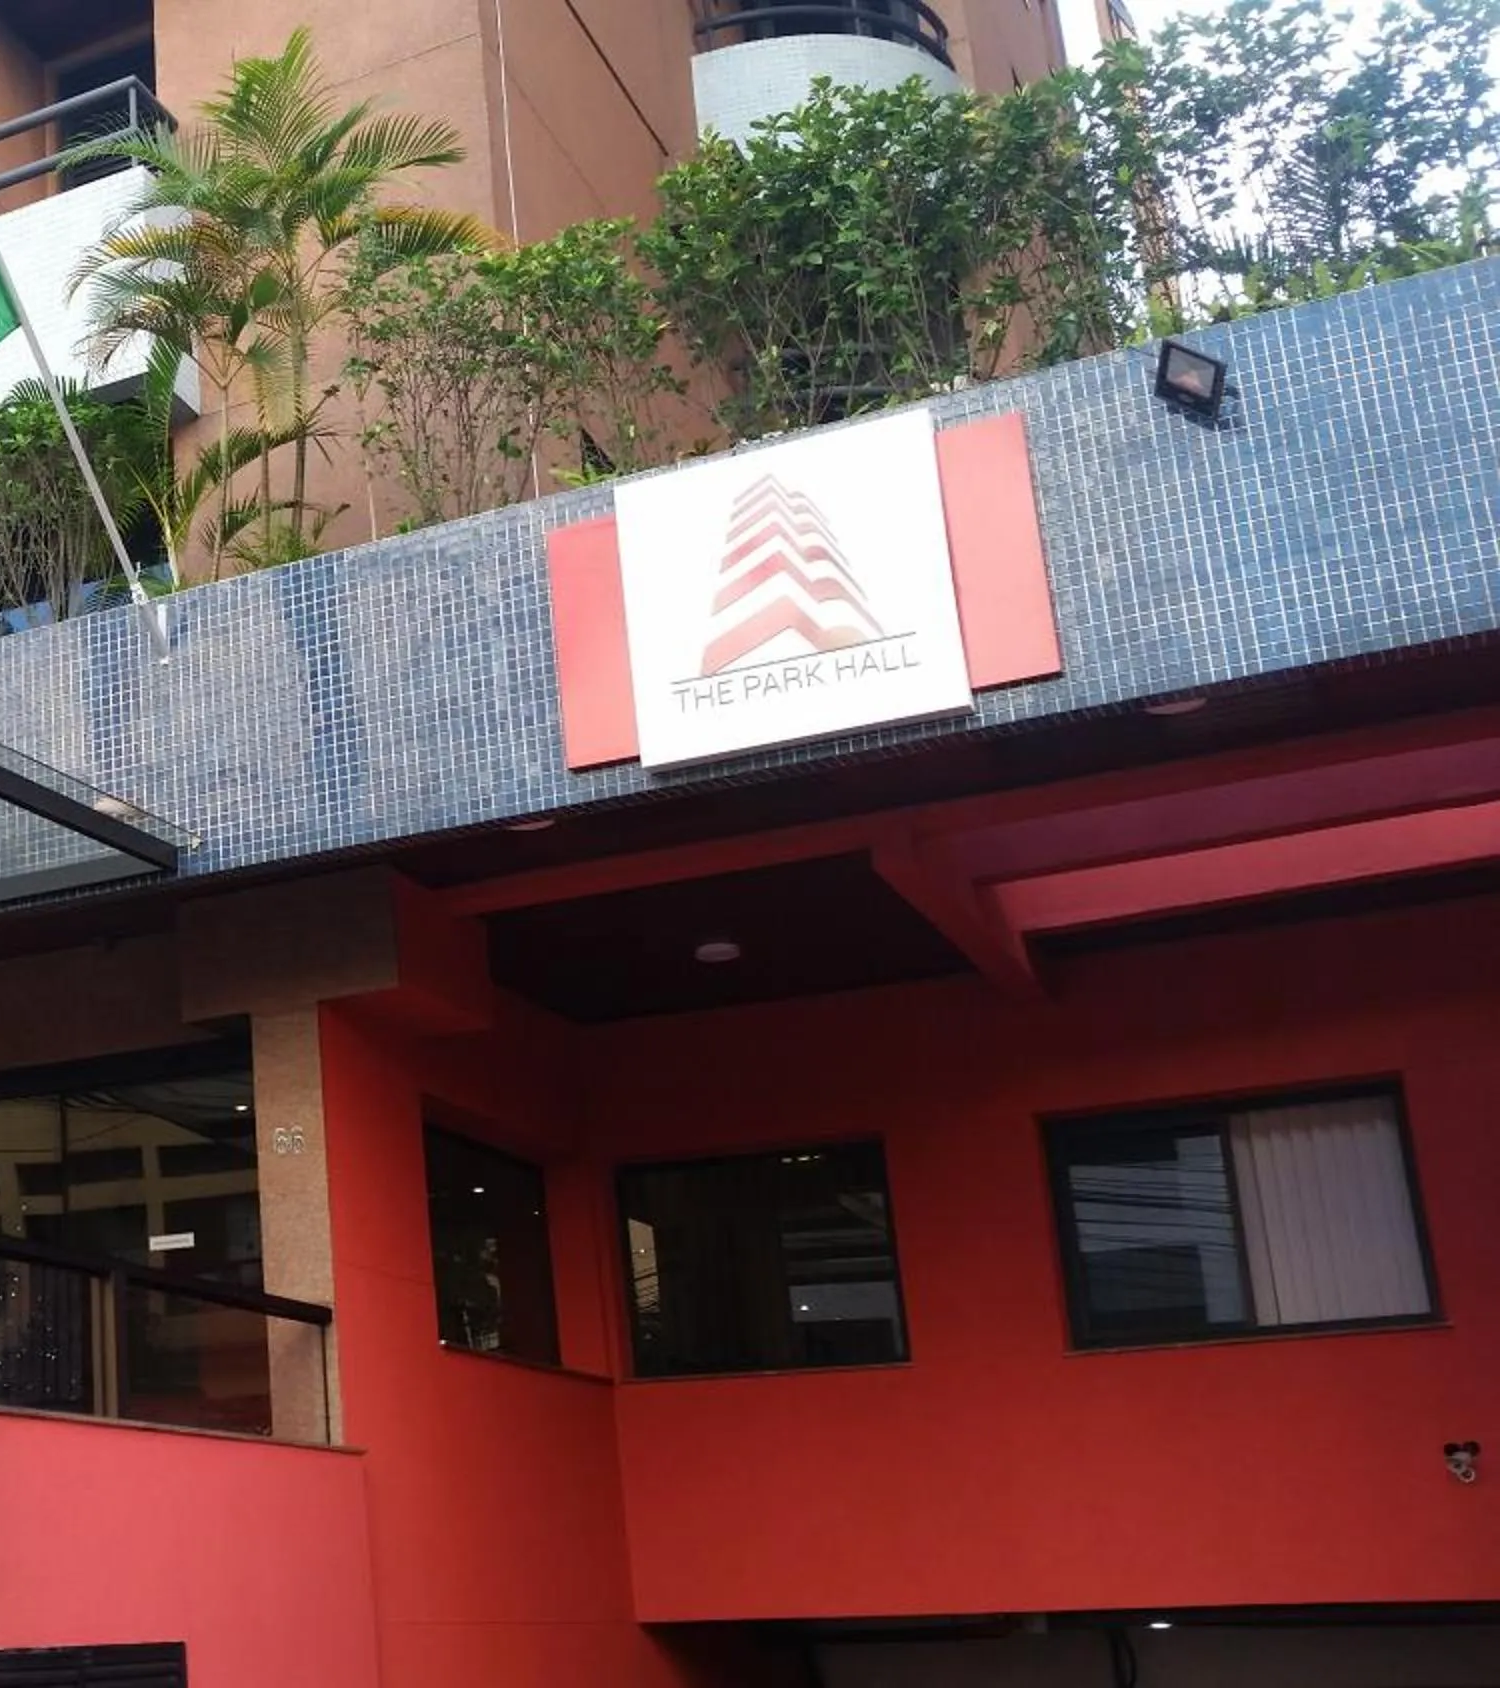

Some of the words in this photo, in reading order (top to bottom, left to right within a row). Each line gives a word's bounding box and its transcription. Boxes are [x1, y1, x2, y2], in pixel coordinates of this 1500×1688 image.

[671, 679, 735, 714] THE
[743, 661, 825, 700] PARK
[835, 644, 921, 682] HALL
[273, 1125, 305, 1154] 66
